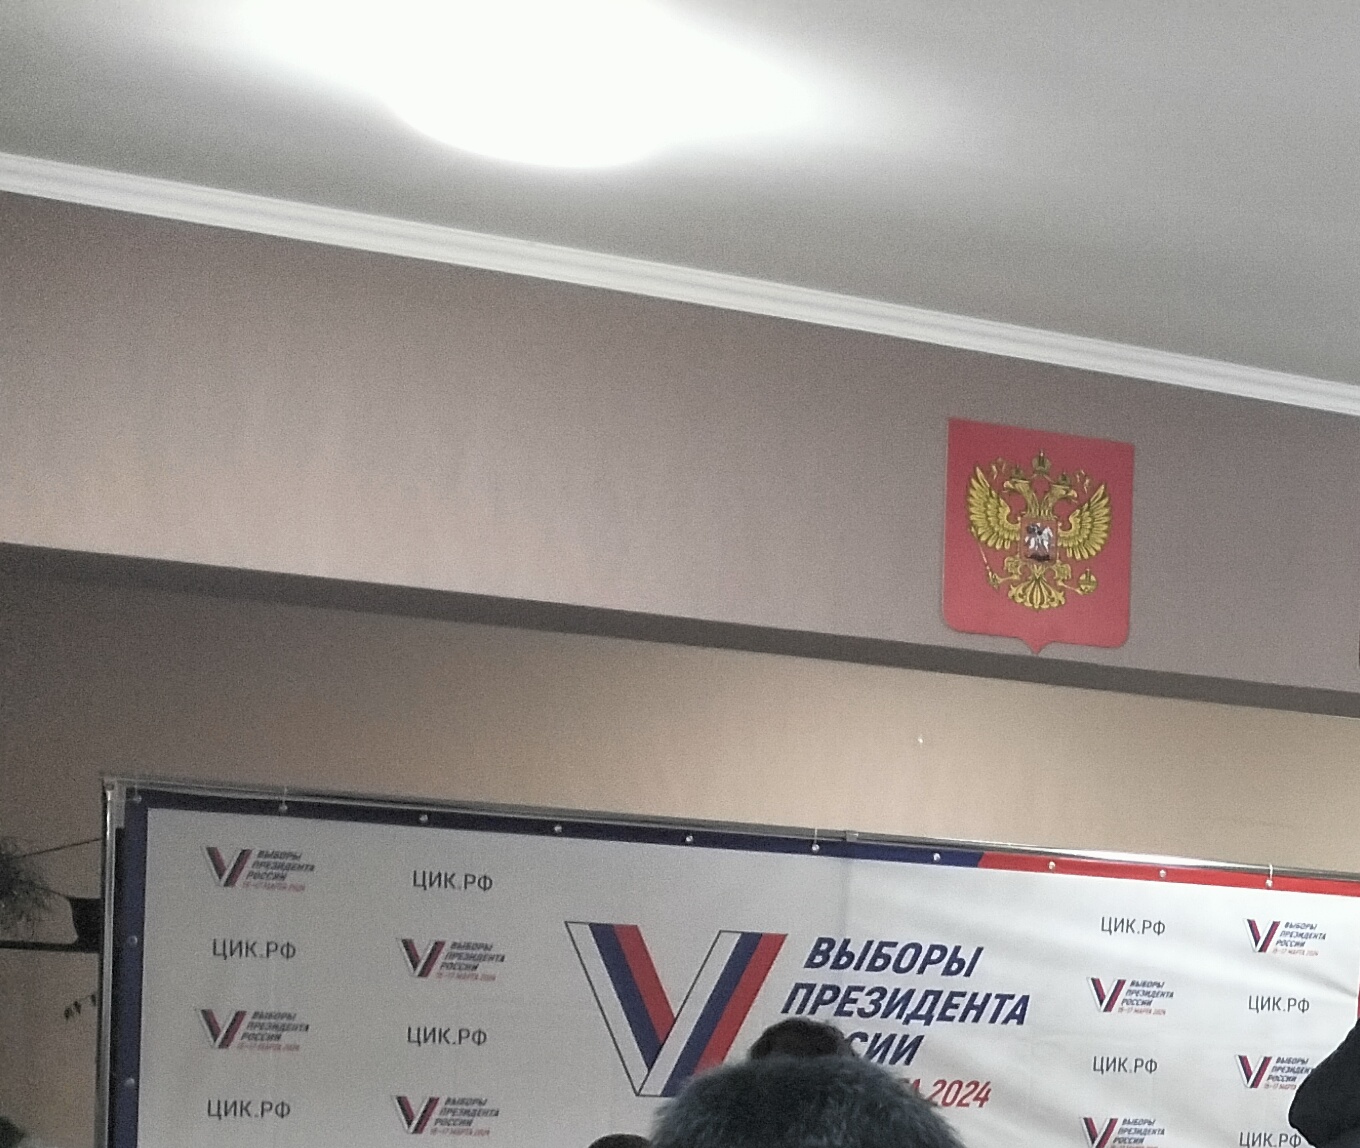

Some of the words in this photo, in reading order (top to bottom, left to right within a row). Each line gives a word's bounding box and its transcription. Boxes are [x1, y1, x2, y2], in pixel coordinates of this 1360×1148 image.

[412, 869, 493, 892] ЦИК.РФ
[1100, 916, 1166, 936] ЦИК.РФ
[1280, 930, 1327, 940] ПРЕЗИДЕНТА
[212, 938, 297, 960] ЦИК.РФ
[804, 936, 985, 979] ВЫБОРЫ
[780, 982, 1031, 1027] ПРЕЗИДЕНТА
[1125, 989, 1174, 998] ПРЕЗИДЕНТА
[1248, 995, 1310, 1014] ЦИК.РФ
[407, 1025, 488, 1047] ЦИК.РФ
[848, 1031, 925, 1066] СИИ
[1092, 1055, 1158, 1074] ЦИК.РФ
[1271, 1065, 1310, 1074] ПРЕЗИДЕН
[928, 1078, 992, 1108] 2024
[207, 1098, 291, 1121] ЦИК.РФ
